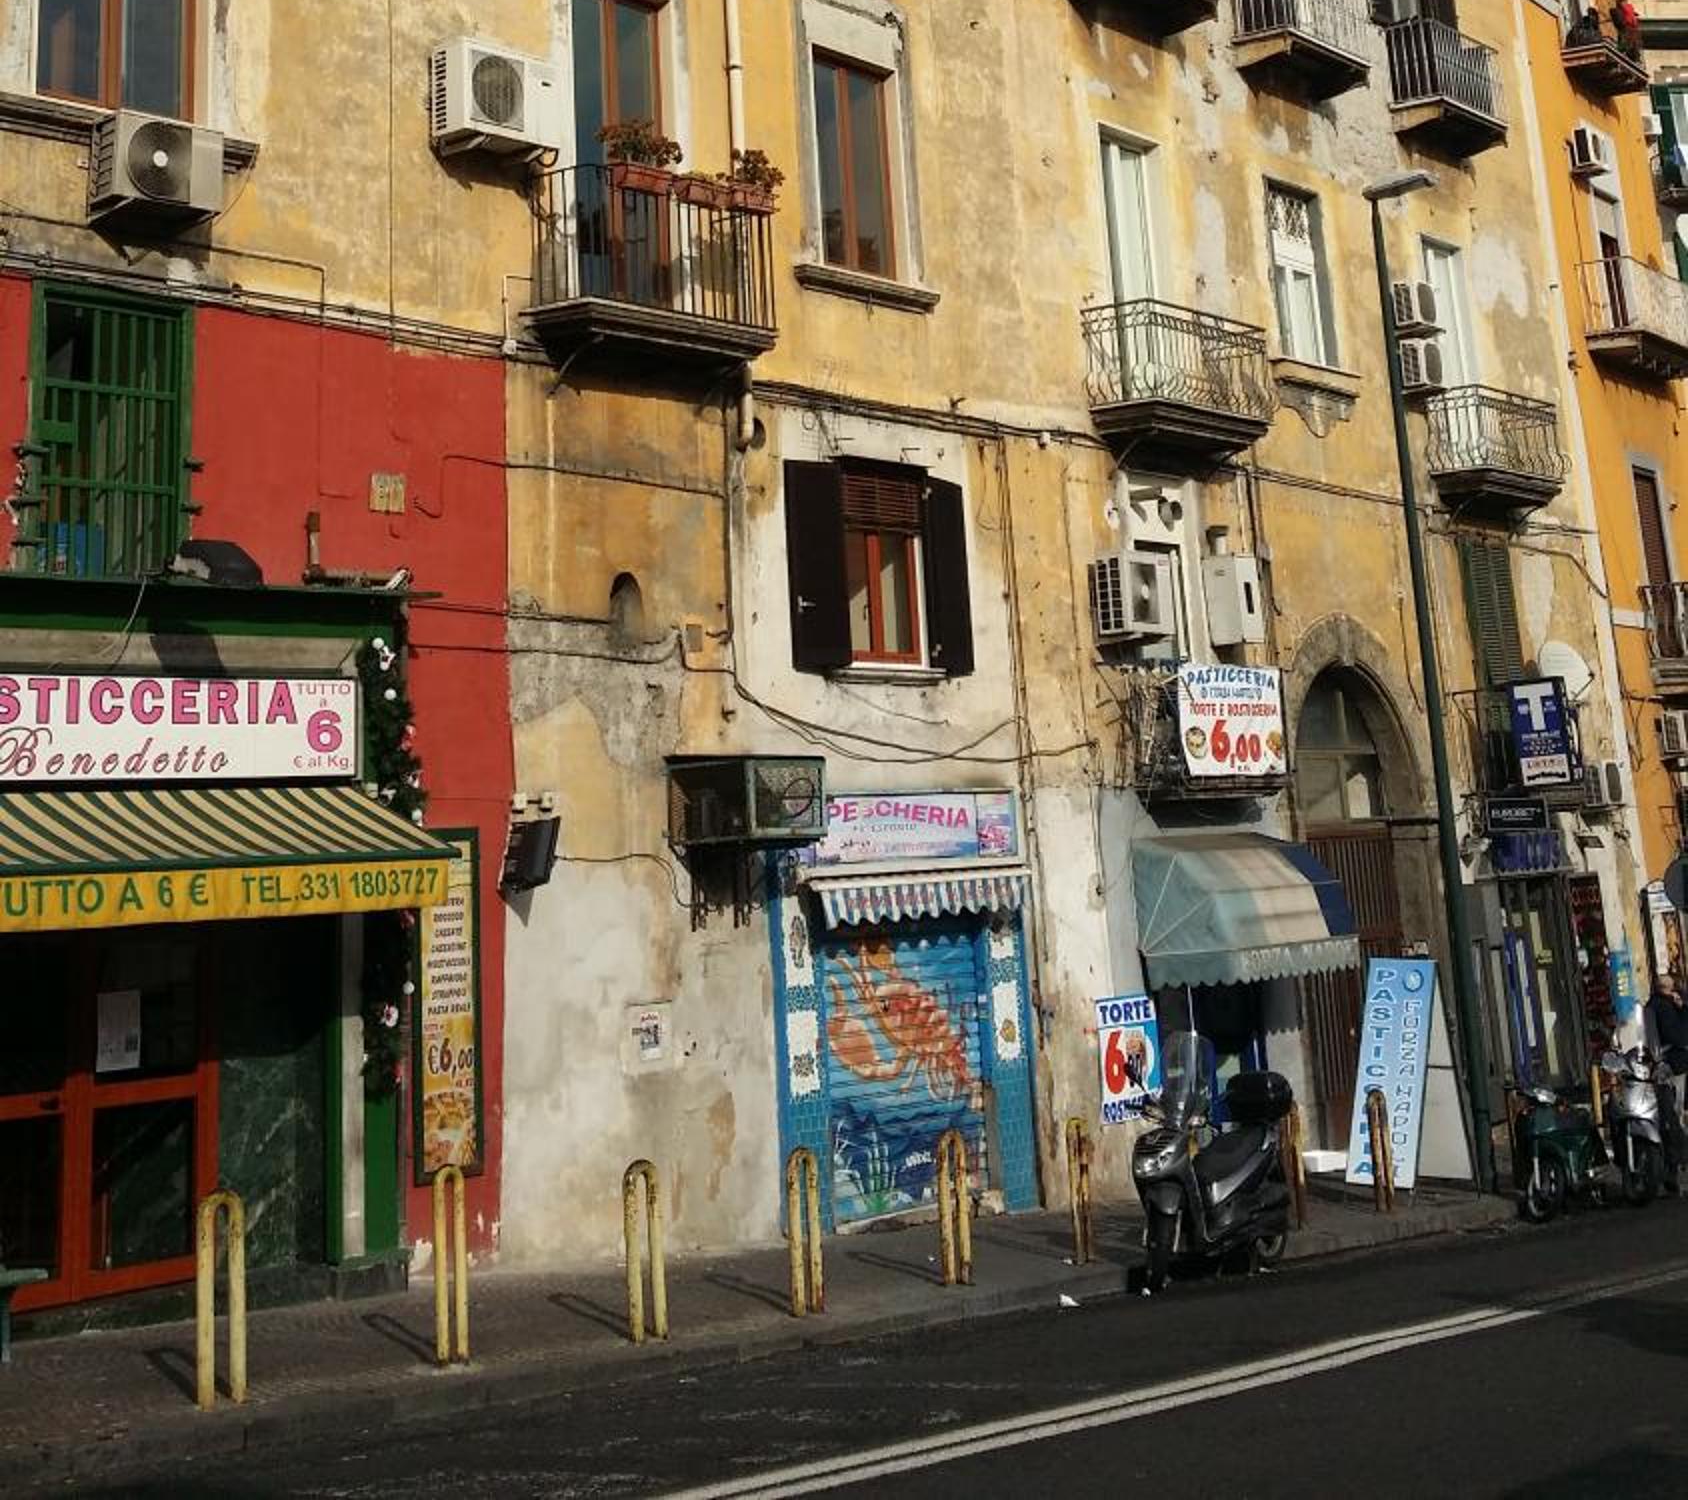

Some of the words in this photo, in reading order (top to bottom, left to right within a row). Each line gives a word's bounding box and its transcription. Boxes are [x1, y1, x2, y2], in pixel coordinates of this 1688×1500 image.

[296, 682, 352, 696] TUTTO
[1187, 666, 1275, 690] PASTICCERIA
[1219, 702, 1226, 717] E
[1514, 681, 1555, 731] T
[307, 710, 343, 753] 6
[0, 727, 229, 778] Benedetto
[0, 879, 105, 917] UTTO
[119, 876, 144, 911] A
[158, 875, 175, 909] 6
[190, 873, 209, 906] €
[349, 867, 438, 899] 1803727
[1100, 1000, 1152, 1024] TORTE
